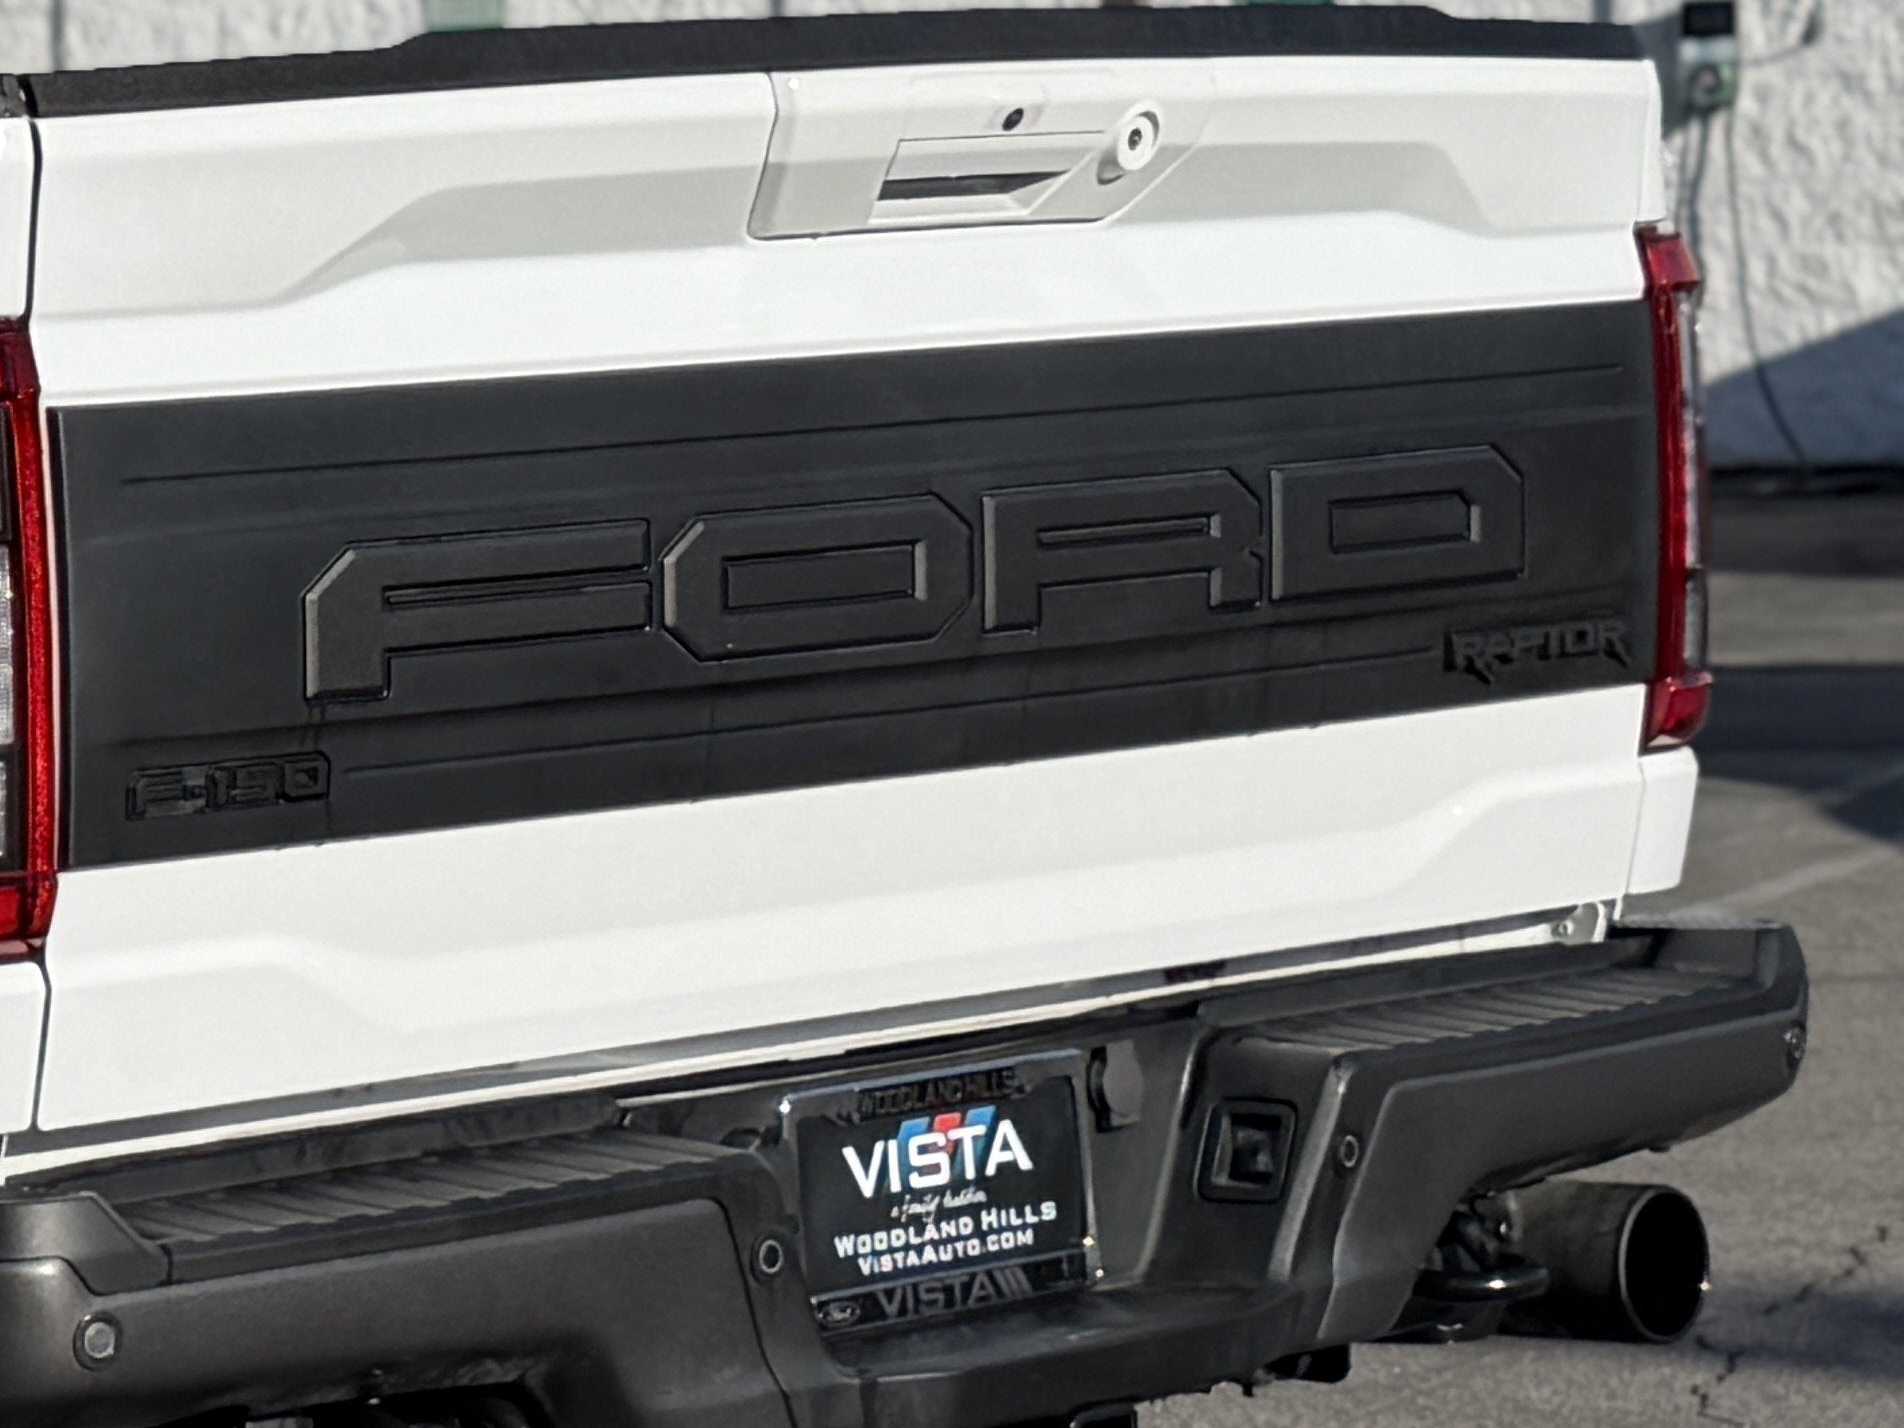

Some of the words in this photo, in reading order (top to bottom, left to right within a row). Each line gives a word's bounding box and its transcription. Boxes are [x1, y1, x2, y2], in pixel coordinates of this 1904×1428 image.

[301, 442, 1527, 705] FORD
[1445, 618, 1634, 684] RAPTOR
[125, 750, 332, 822] F-150
[842, 1119, 1034, 1199] VISTA
[834, 1216, 974, 1259] WOODLAND
[980, 1200, 1058, 1231] HILLS
[875, 1269, 998, 1320] VISTA
